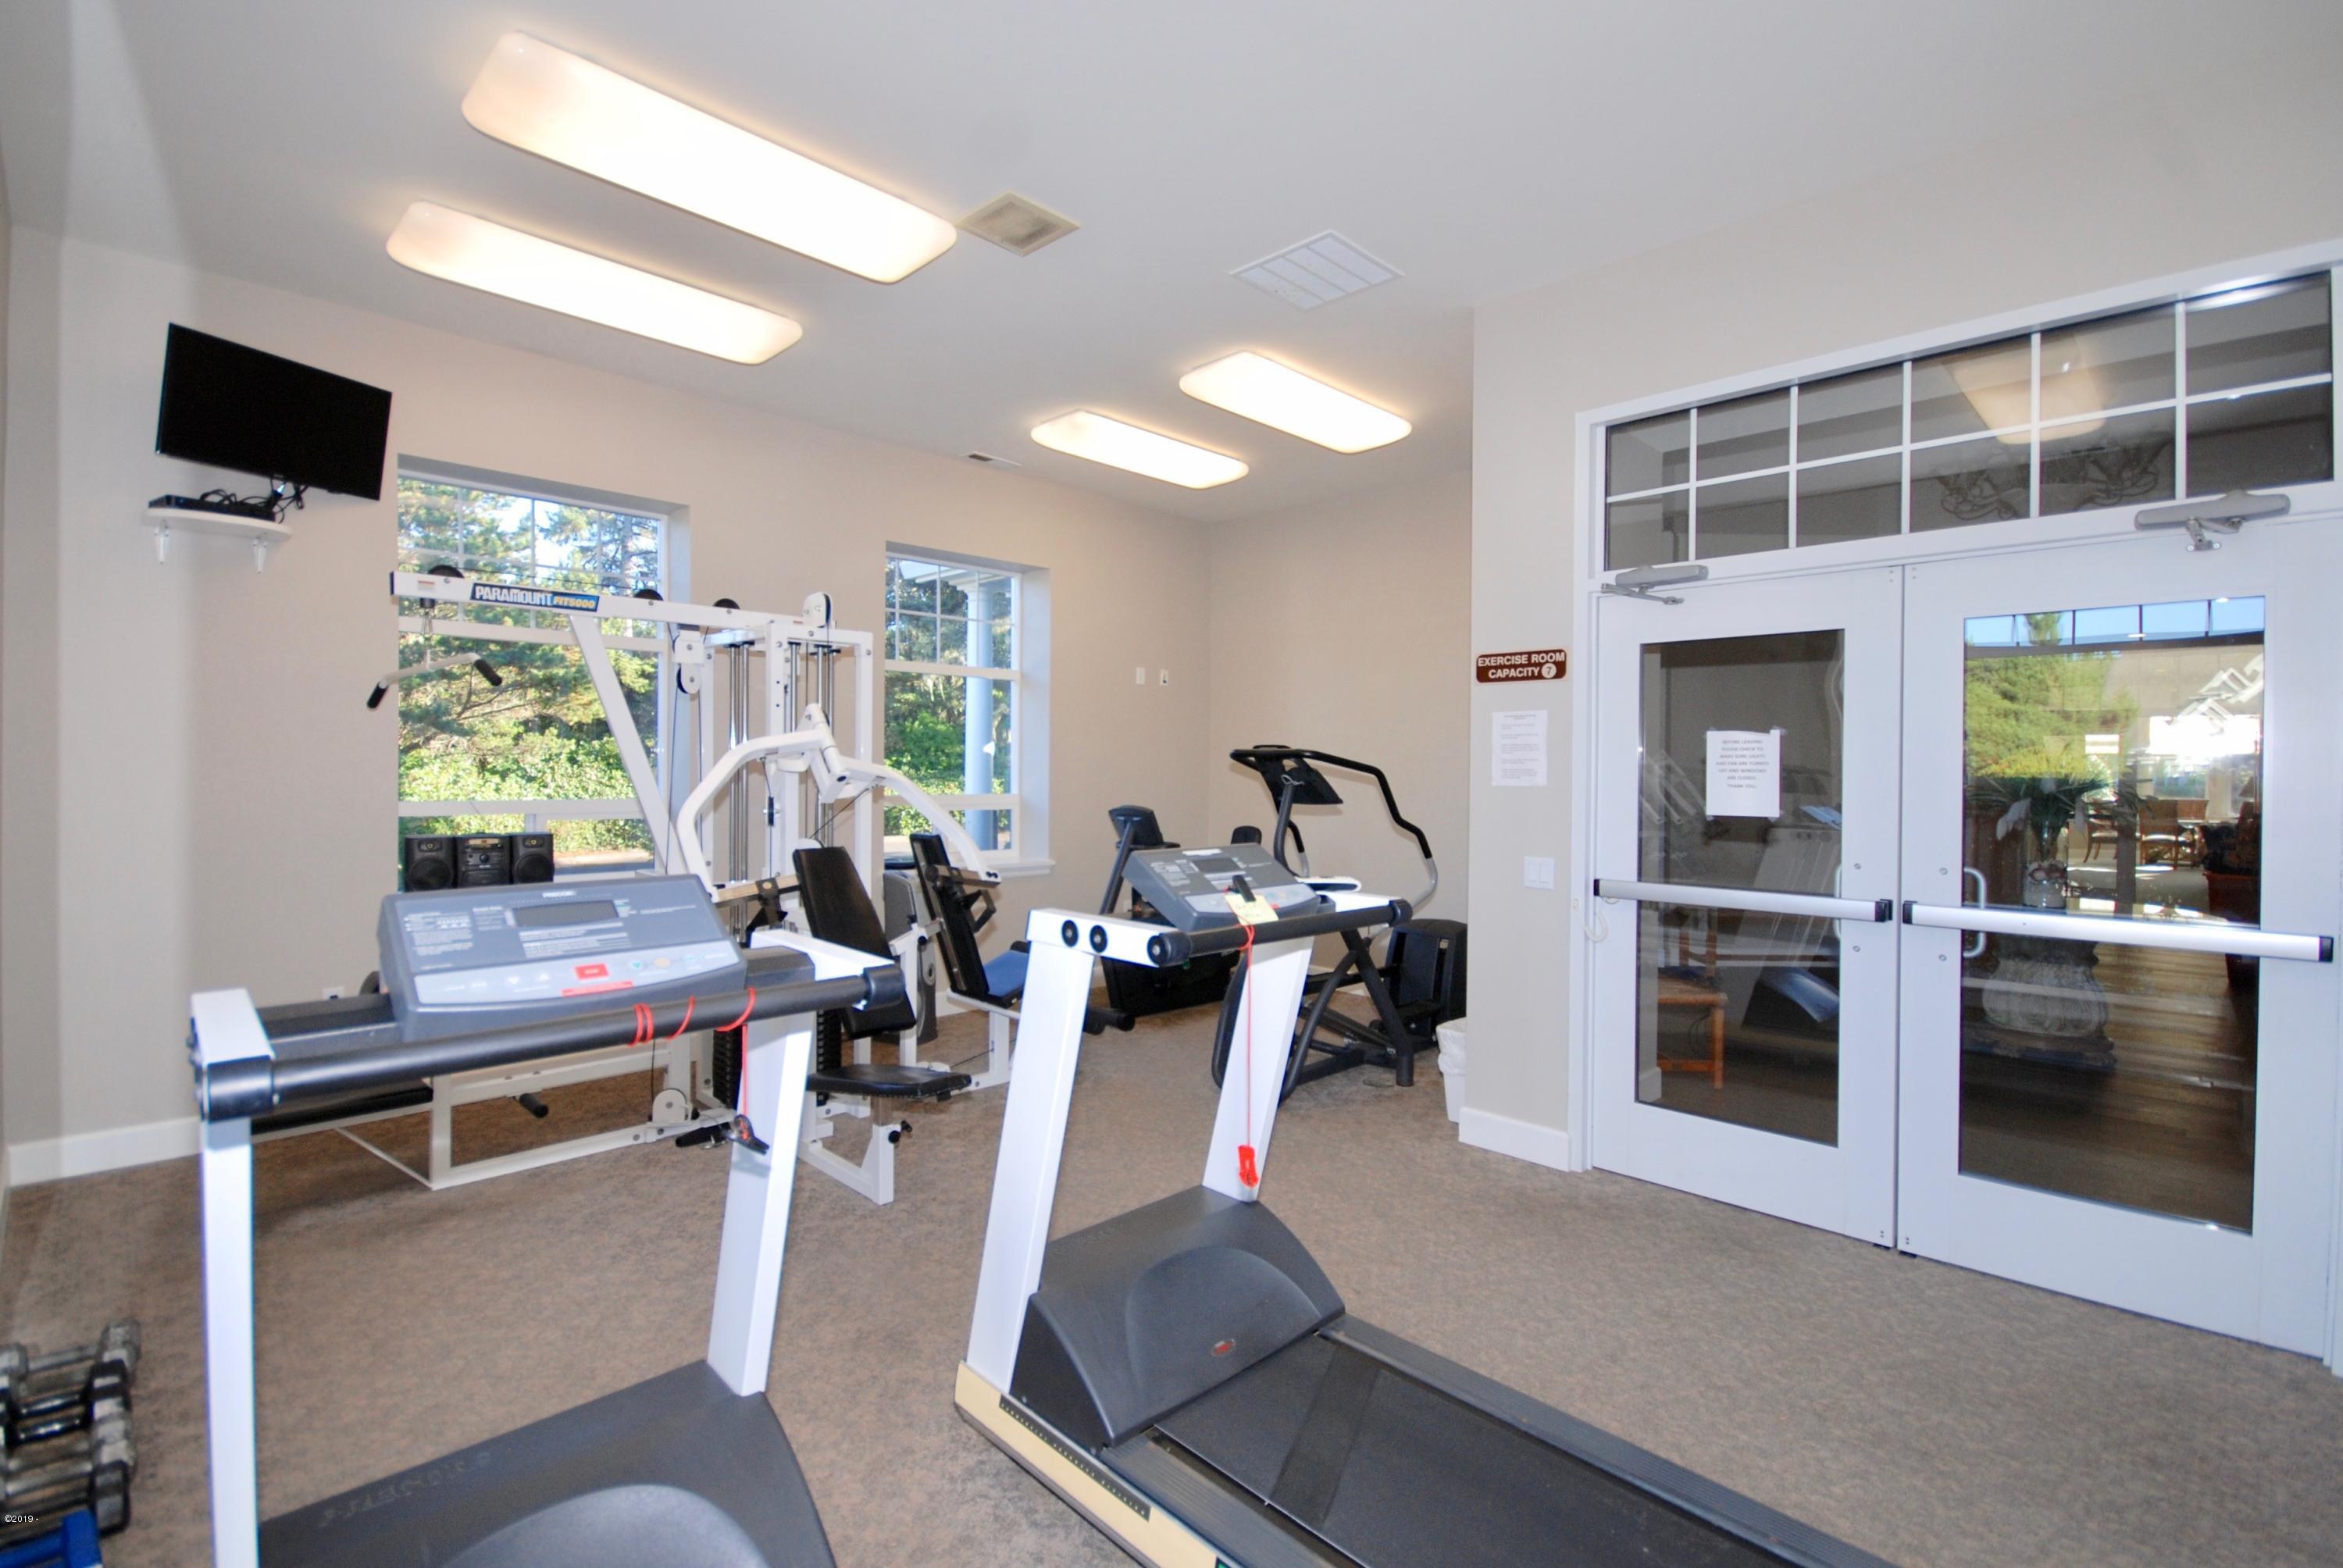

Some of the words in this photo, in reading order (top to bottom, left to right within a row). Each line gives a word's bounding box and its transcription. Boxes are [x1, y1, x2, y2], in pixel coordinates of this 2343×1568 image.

[475, 586, 553, 606] PARAMOUNT
[1478, 654, 1528, 667] EXERCISE
[1532, 651, 1565, 664] ROOM
[1489, 667, 1540, 679] CAPACITY
[1546, 666, 1552, 675] 7
